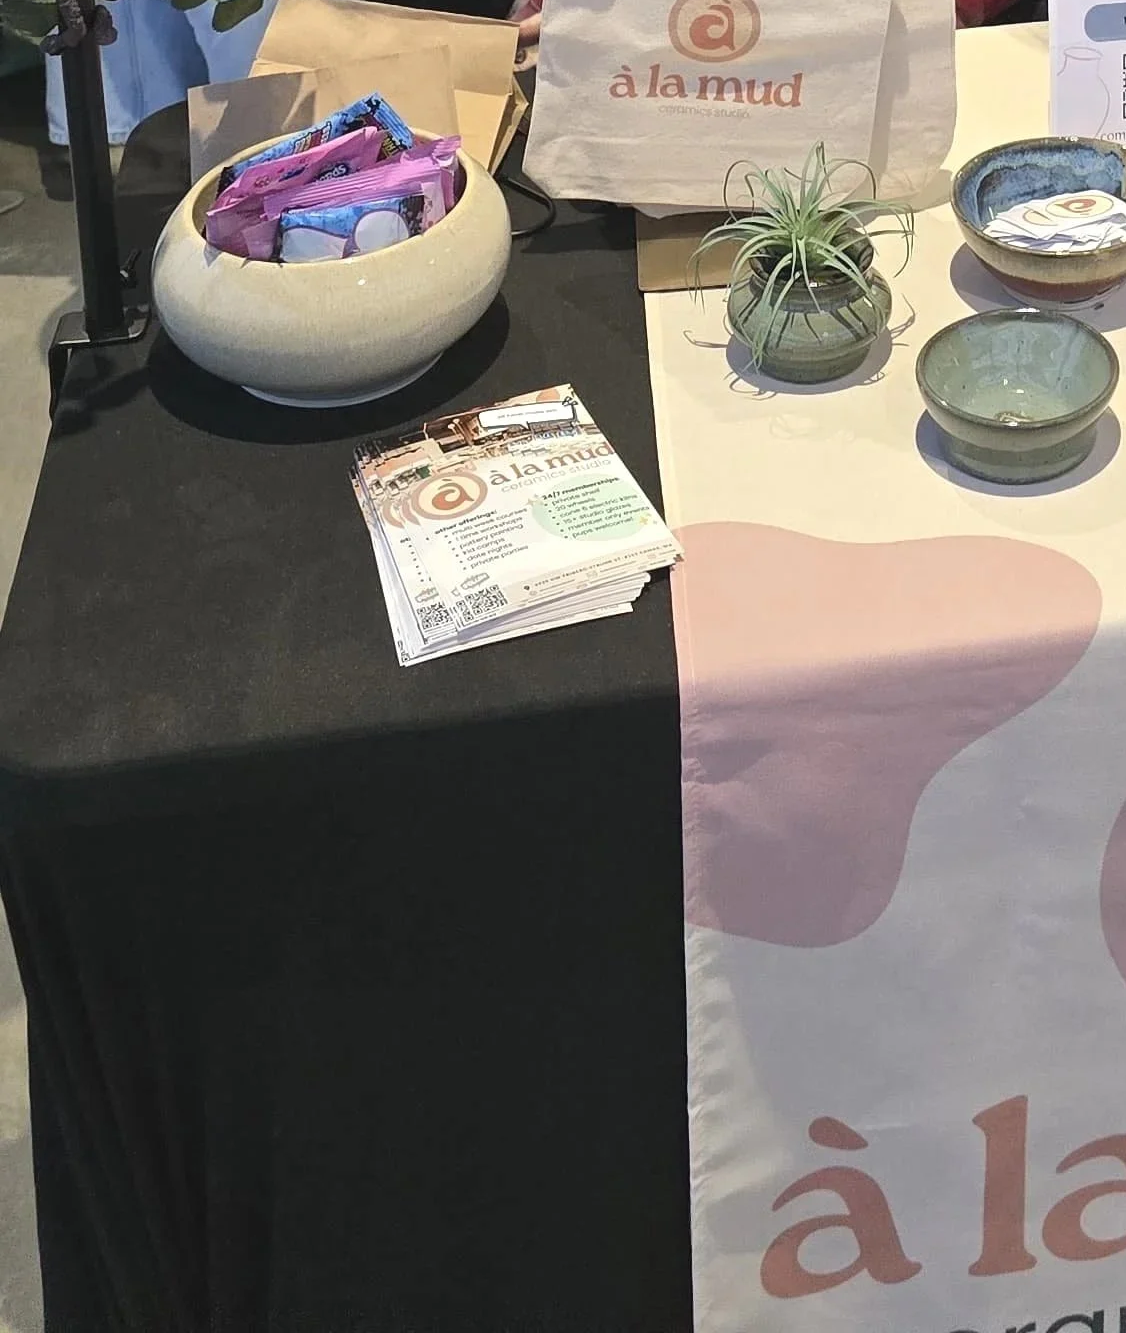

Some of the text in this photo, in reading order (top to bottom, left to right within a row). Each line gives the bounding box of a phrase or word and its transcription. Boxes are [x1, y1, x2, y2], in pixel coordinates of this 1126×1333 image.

[609, 64, 804, 108] à la mud
[489, 441, 617, 487] à la mud
[501, 458, 612, 493] ceramics studio
[760, 1115, 923, 1299] à
